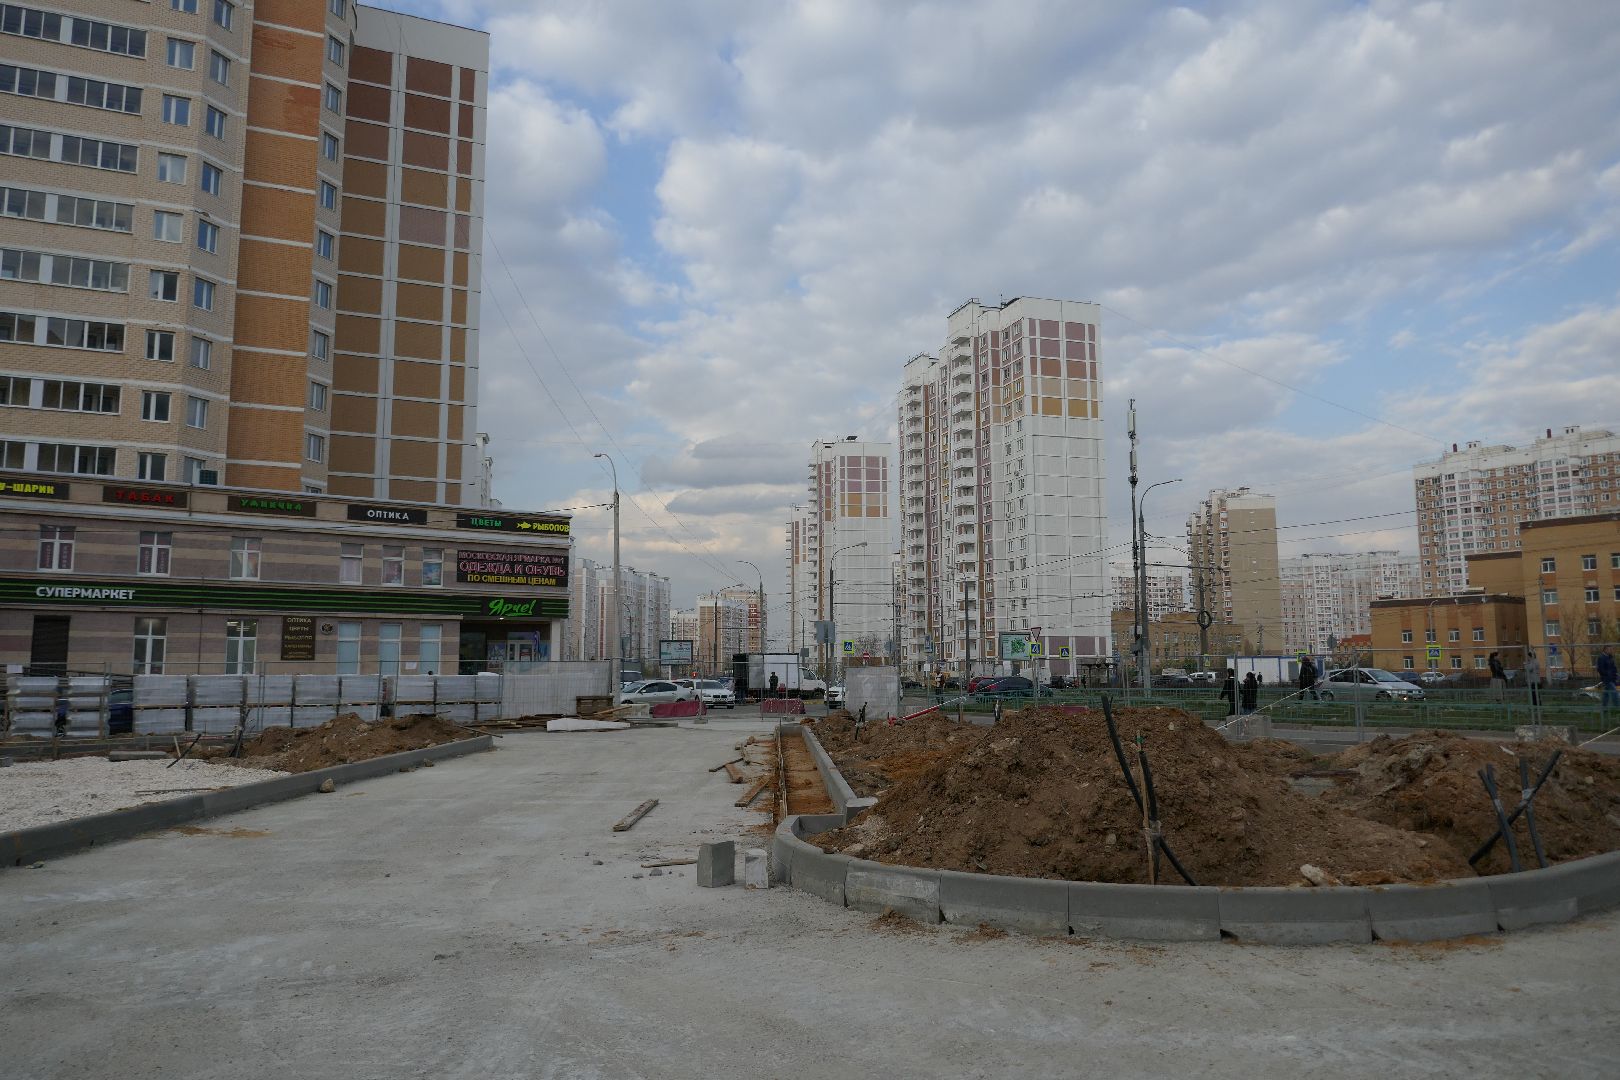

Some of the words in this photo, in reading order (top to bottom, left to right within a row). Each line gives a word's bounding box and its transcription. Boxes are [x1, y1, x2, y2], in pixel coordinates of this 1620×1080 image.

[115, 490, 174, 503] ТАБАК
[367, 510, 409, 520] ОПТИКА
[470, 517, 502, 528] ЦВЕТЫ
[532, 522, 570, 532] РЫБОЛОВ
[459, 561, 512, 574] ОДЕЖДА
[514, 564, 523, 574] И
[467, 574, 480, 582] ПО
[482, 575, 526, 584] СМЕШНЫМ
[528, 576, 556, 585] ЦЕНАМ
[36, 586, 135, 600] СУПЕРМАРКЕТ
[489, 598, 537, 617] Ярче!
